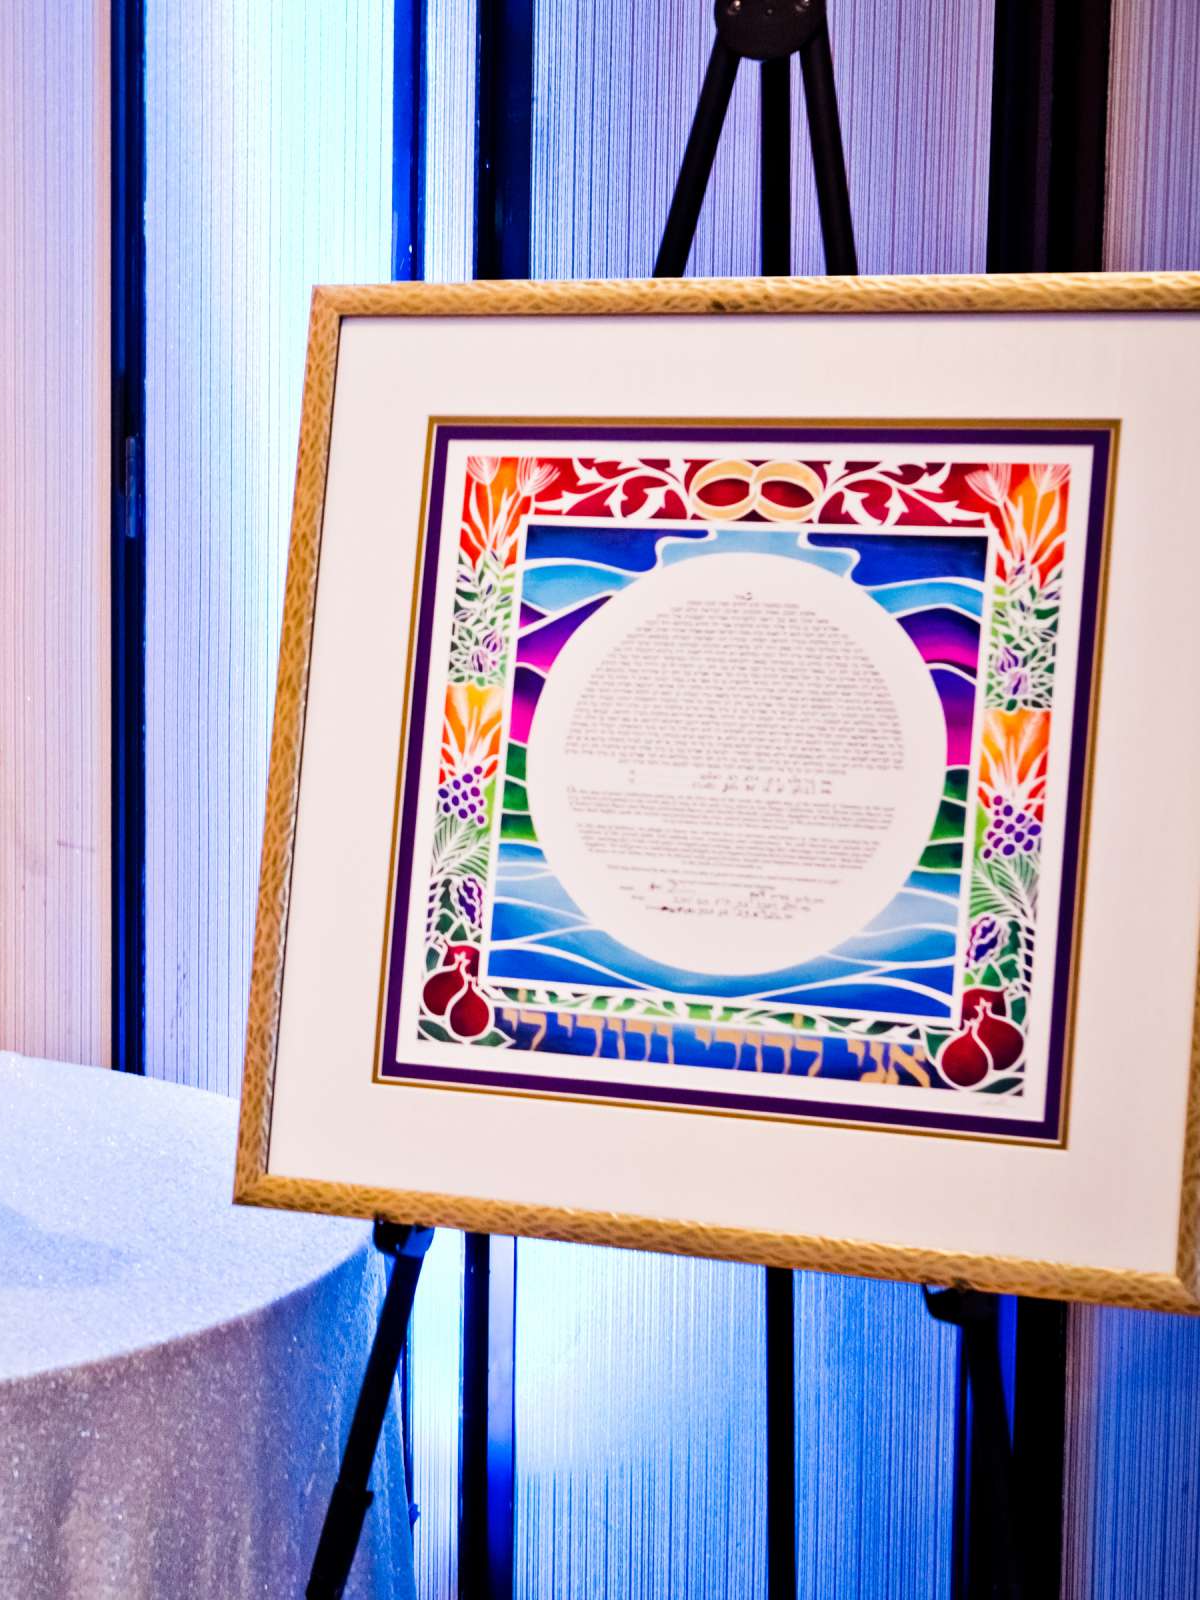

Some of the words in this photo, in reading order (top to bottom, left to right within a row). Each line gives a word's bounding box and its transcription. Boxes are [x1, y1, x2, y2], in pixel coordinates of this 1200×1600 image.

[502, 989, 547, 1051] לי
[557, 1012, 675, 1064] ודודי
[693, 1013, 823, 1077] לדודי
[847, 1038, 931, 1088] אני
